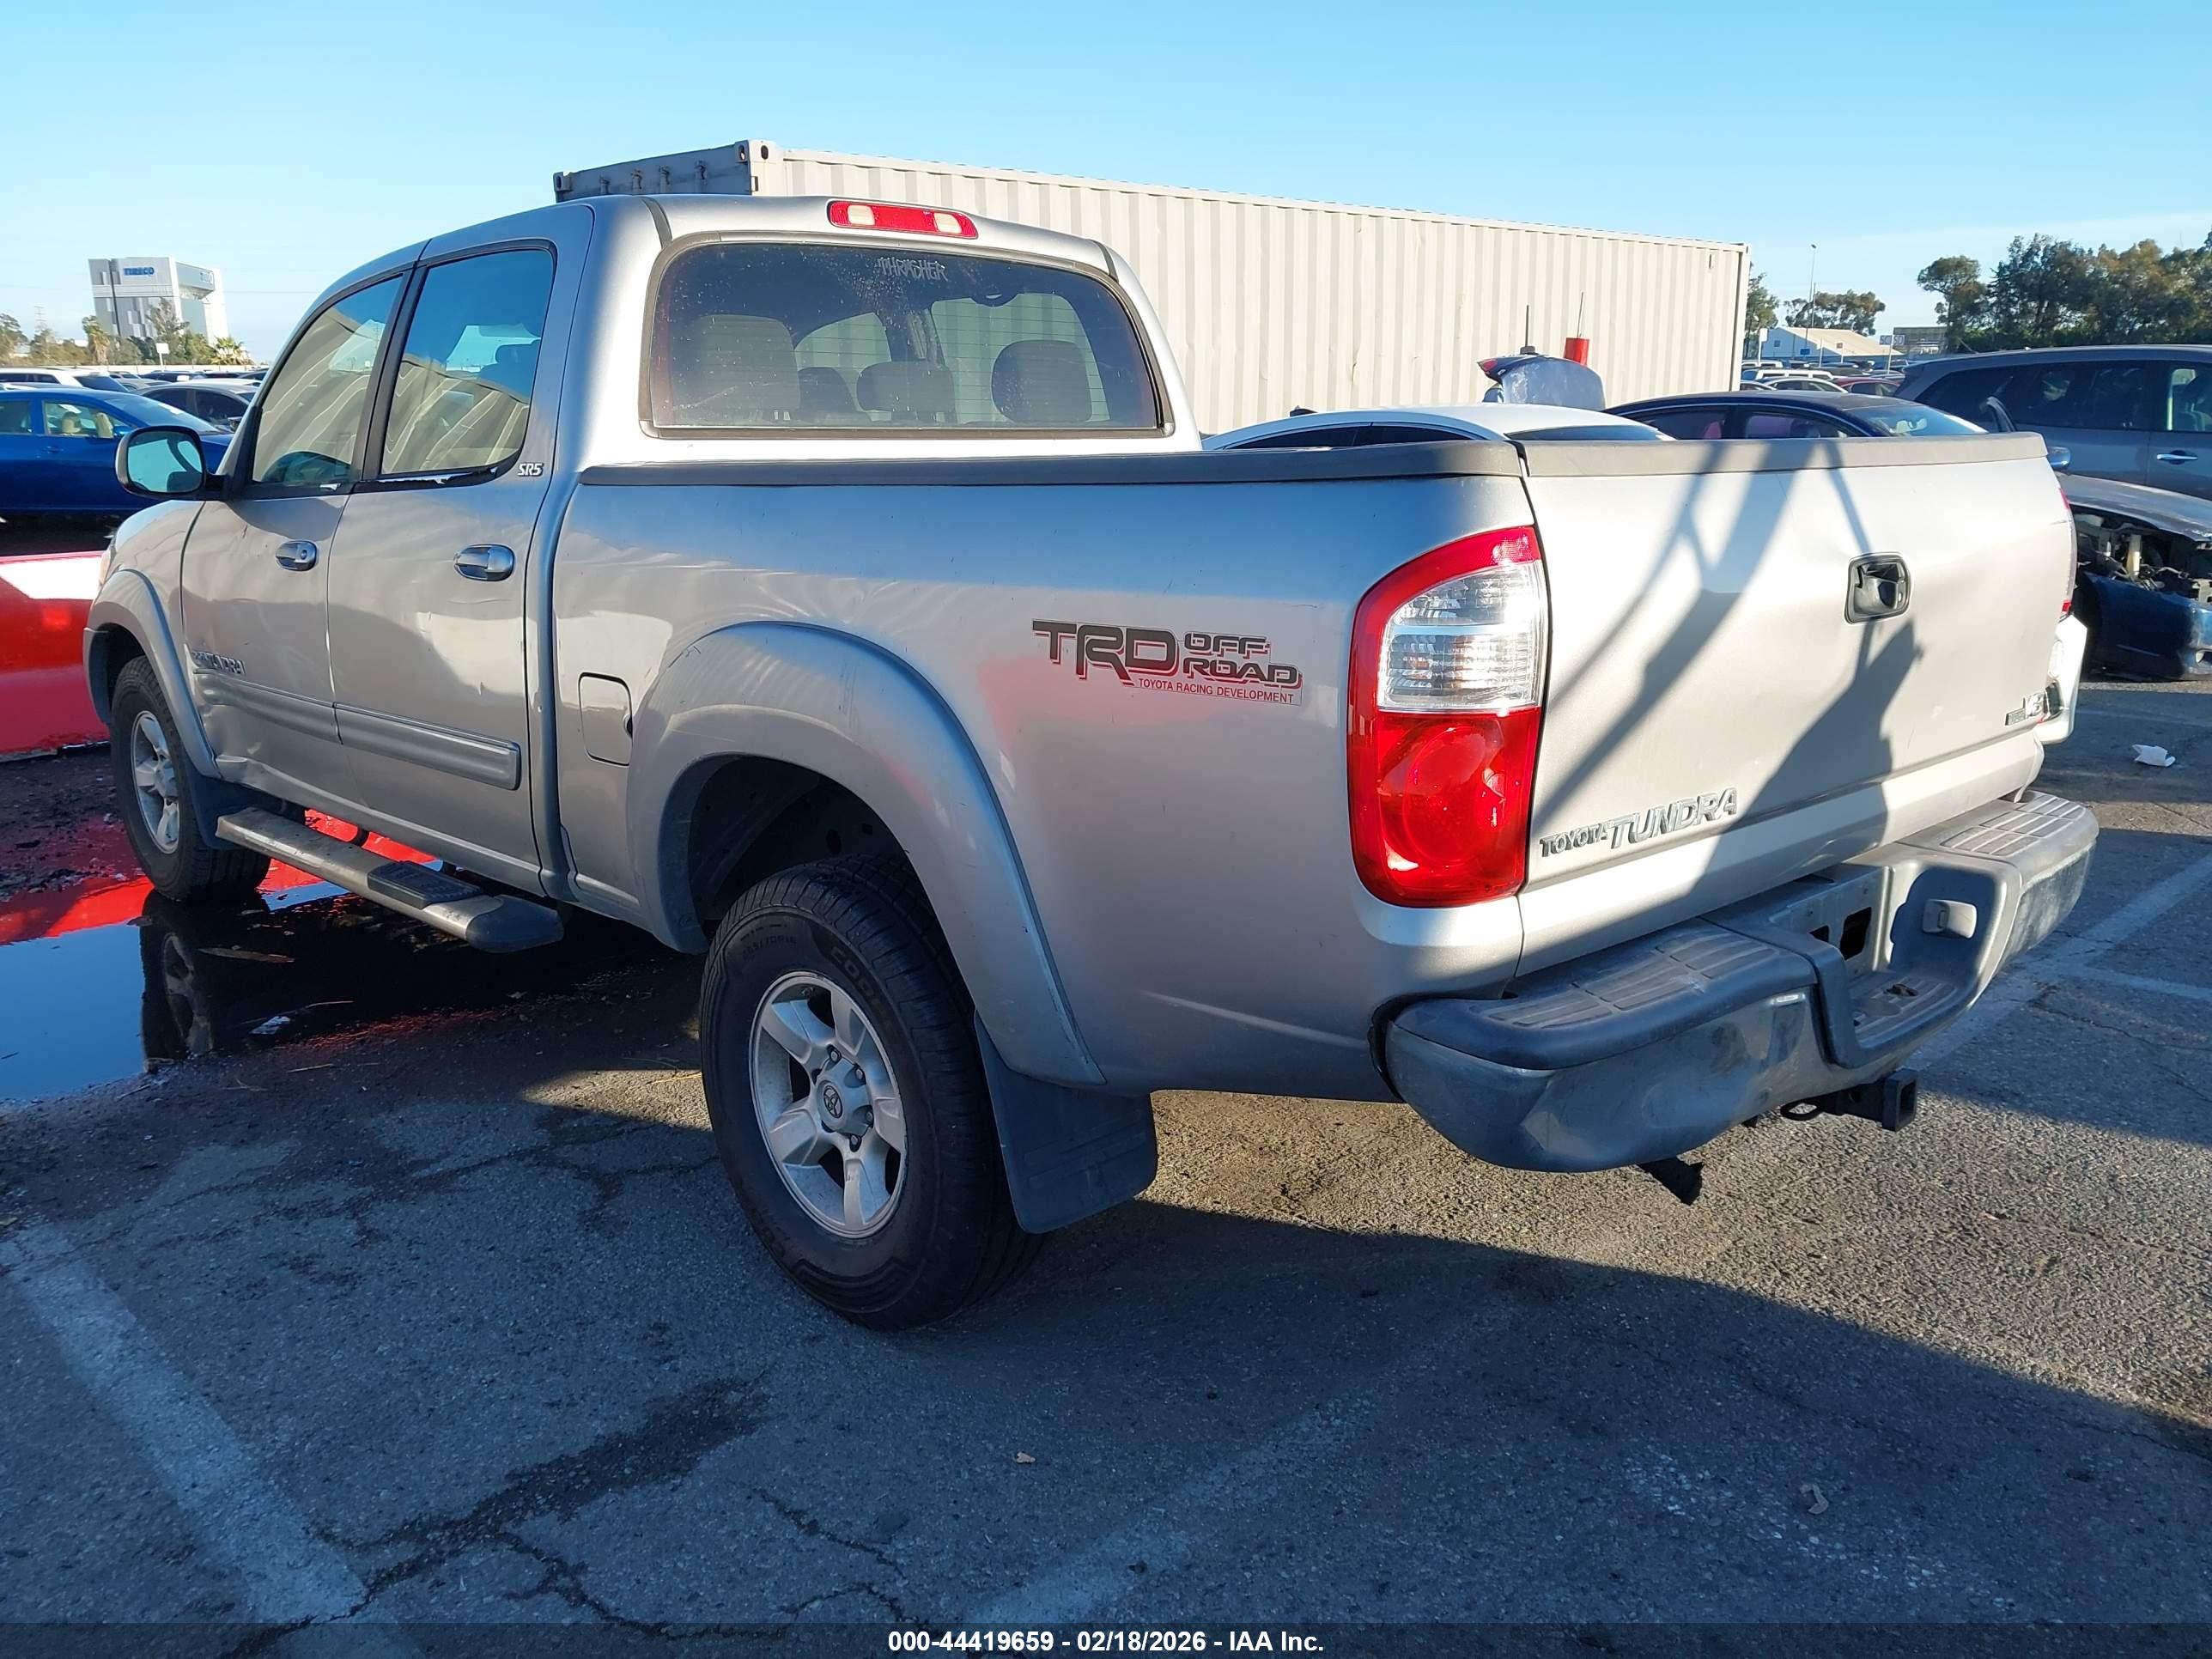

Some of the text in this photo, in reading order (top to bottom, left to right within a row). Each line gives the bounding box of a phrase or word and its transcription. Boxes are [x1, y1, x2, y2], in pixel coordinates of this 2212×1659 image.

[517, 462, 544, 477] SR5
[1032, 620, 1180, 686] TRD
[1183, 632, 1270, 659] OFF
[1182, 656, 1303, 690] ROAD
[1138, 677, 1295, 704] TOYOTA RACING DEVELOPMENT
[1540, 787, 1738, 857] TOYOTA TUNDRA
